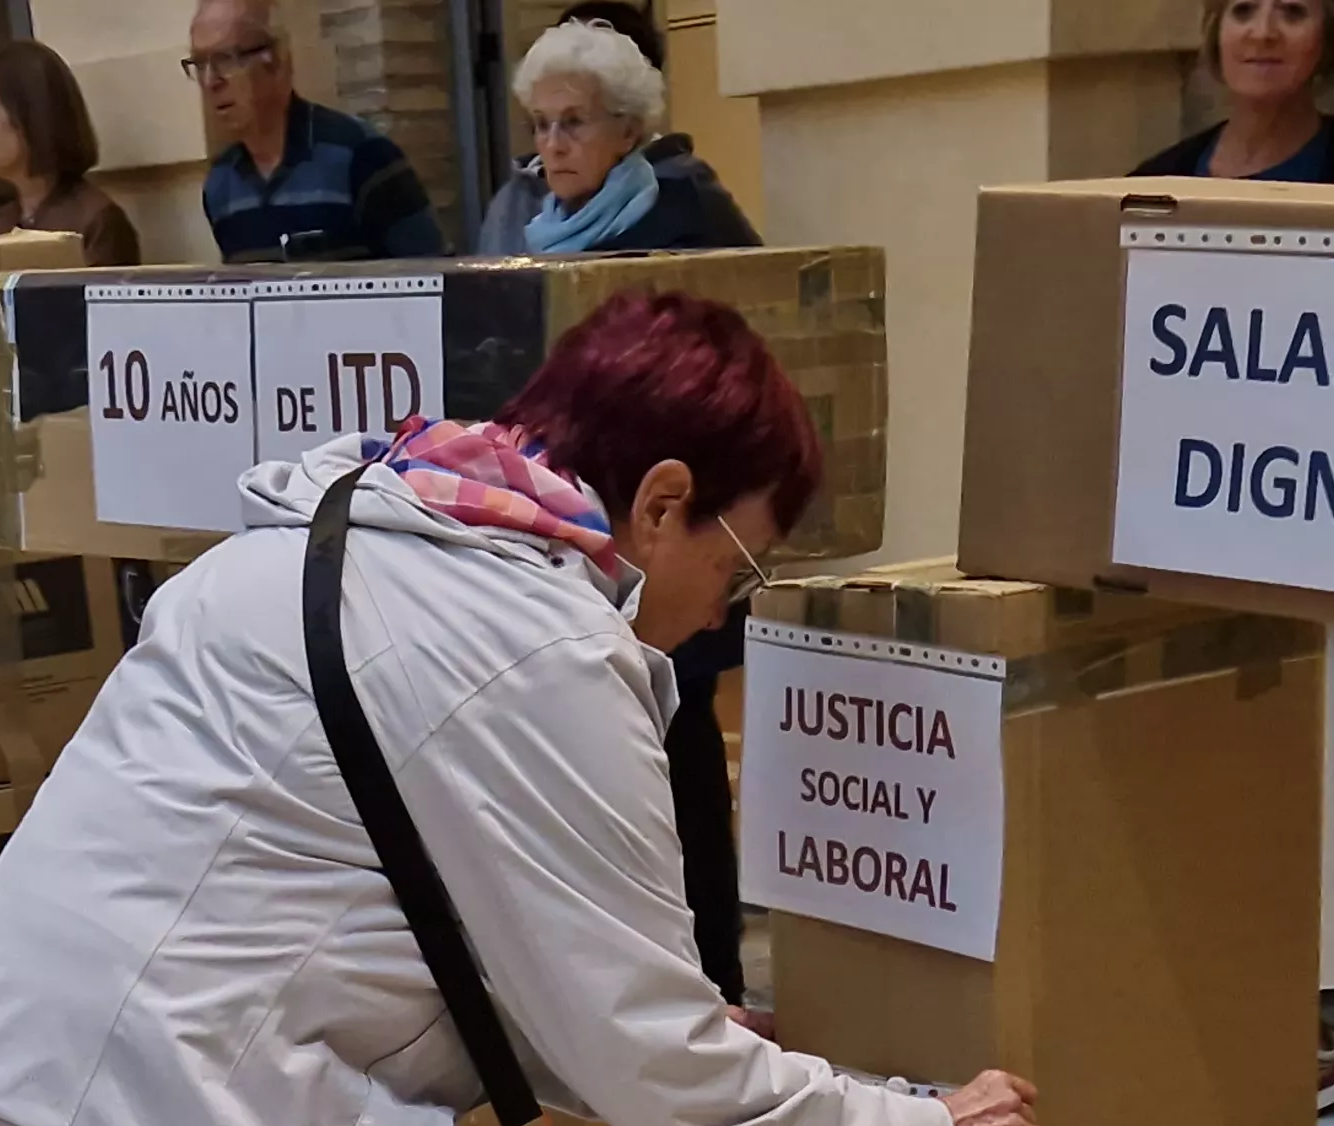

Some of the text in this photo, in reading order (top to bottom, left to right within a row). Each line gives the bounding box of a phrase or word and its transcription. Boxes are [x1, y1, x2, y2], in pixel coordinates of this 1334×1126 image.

[99, 350, 239, 424] 10 AÑOS
[276, 352, 422, 434] DE ITD
[779, 686, 956, 760] JUSTICIA
[800, 767, 937, 825] SOCIAL Y
[778, 830, 958, 913] LABORAL
